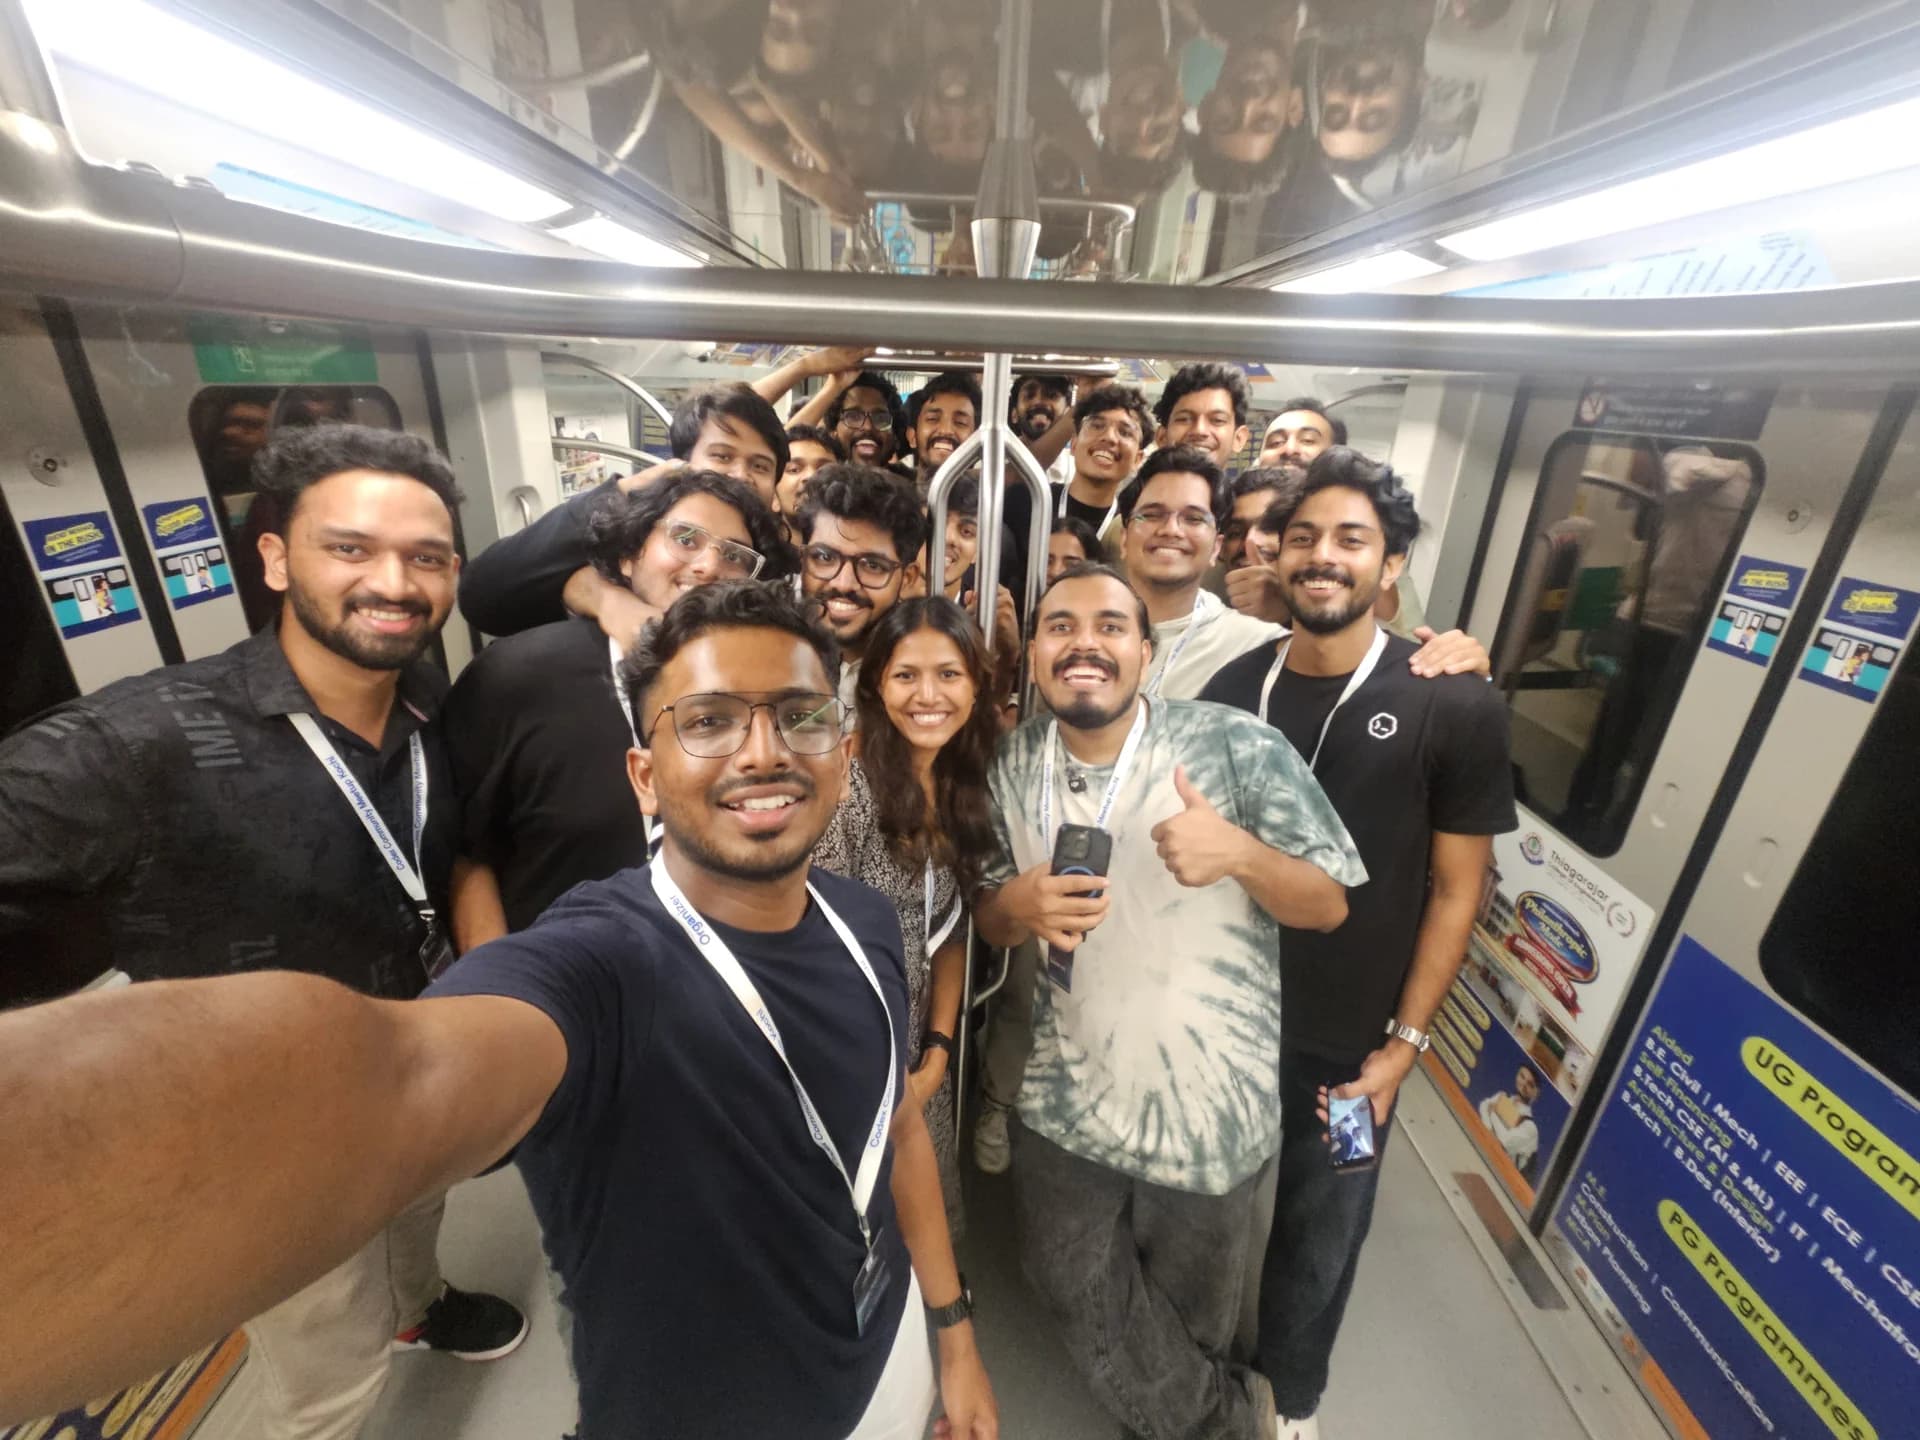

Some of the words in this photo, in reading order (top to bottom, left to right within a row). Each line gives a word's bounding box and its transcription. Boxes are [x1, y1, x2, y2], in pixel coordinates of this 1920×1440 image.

[325, 755, 346, 780] Kochi
[345, 778, 370, 810] Meetup
[1551, 850, 1609, 902] Thiagarajar
[669, 895, 711, 946] Organizer
[1524, 898, 1589, 960] Philanthropic
[1652, 1025, 1694, 1067] Aided
[1755, 1046, 1796, 1087] UG
[870, 1110, 887, 1148] Codex
[1639, 1051, 1733, 1149] Self-Financing
[1621, 1089, 1662, 1137] B.Arch
[1673, 1145, 1713, 1191] B.Des
[1713, 1188, 1782, 1264] (Interior)
[1628, 1079, 1705, 1161] Architecture
[1707, 1161, 1719, 1177] &
[1721, 1175, 1775, 1235] Design
[1633, 1064, 1675, 1111] B.Tech
[1676, 1108, 1705, 1140] CSE
[1703, 1136, 1729, 1164] (AI
[1728, 1161, 1741, 1179] &
[1743, 1176, 1774, 1212] ML)
[1789, 1221, 1809, 1242] IT
[1669, 1061, 1702, 1095] Civil
[1712, 1103, 1758, 1150] Mech
[1774, 1160, 1808, 1194] EEE
[1822, 1206, 1863, 1249] ECE
[1570, 1203, 1602, 1248] Urban
[1601, 1245, 1652, 1316] Planning
[1580, 1182, 1650, 1273] Construction
[1660, 1284, 1775, 1432] Communication
[1668, 1210, 1701, 1250] PG
[1702, 1252, 1865, 1440] Programmes
